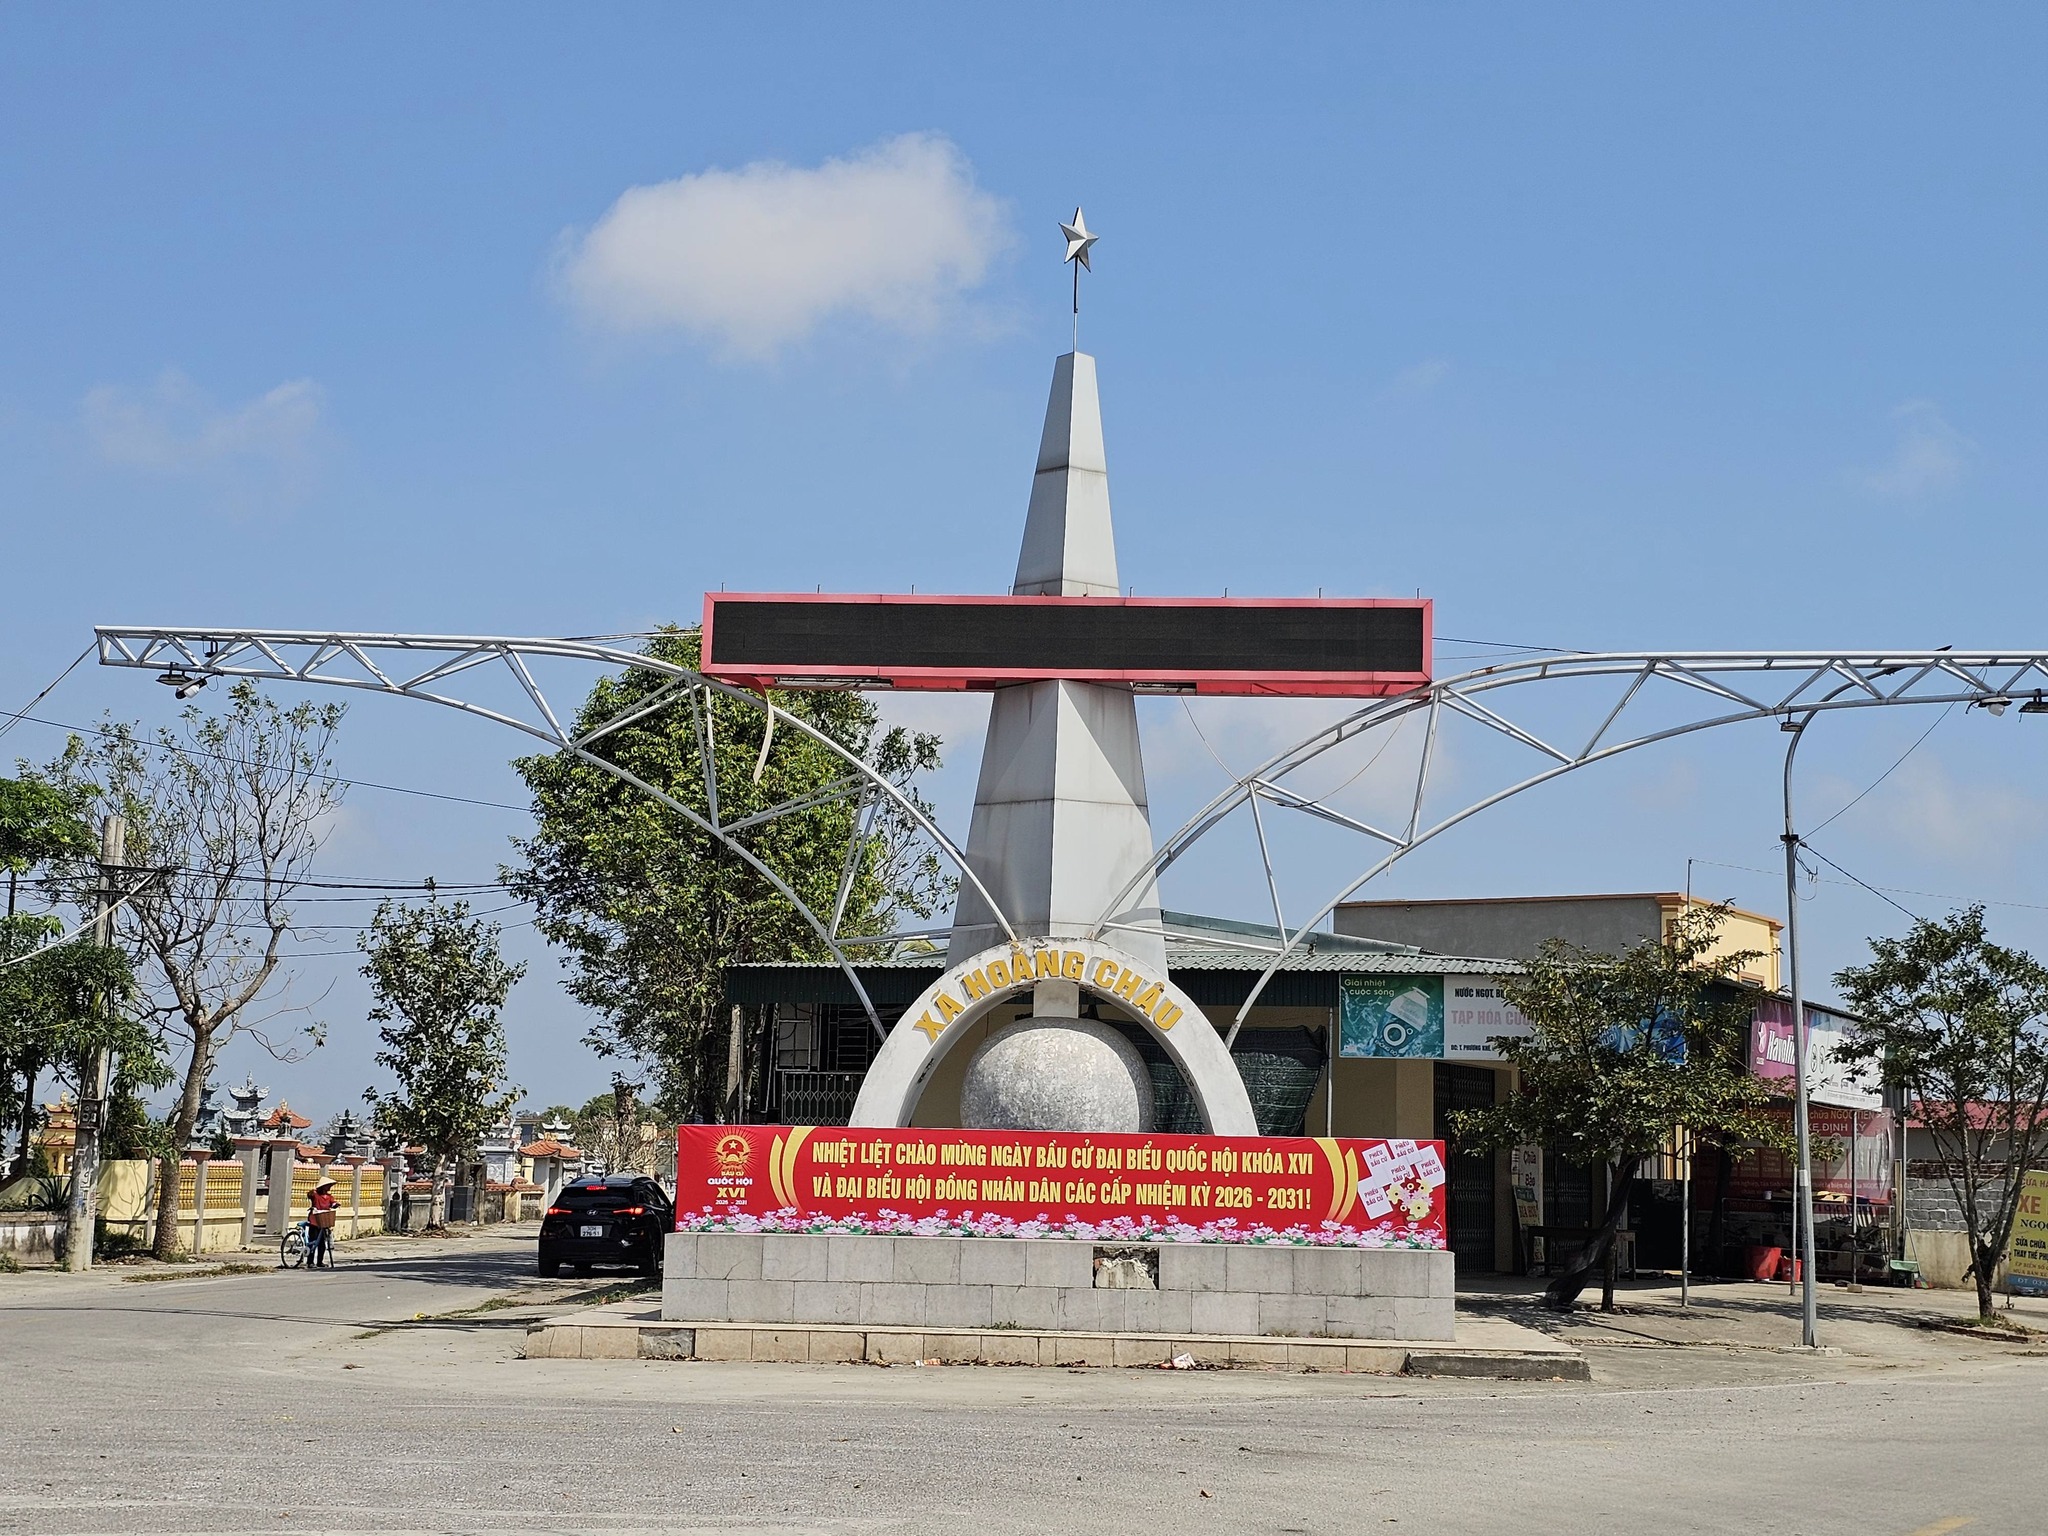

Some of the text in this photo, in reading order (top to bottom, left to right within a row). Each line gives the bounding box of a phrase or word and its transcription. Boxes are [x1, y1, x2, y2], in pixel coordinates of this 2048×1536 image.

[1344, 978, 1386, 987] Giải nhiệt
[1349, 988, 1395, 997] cuộc sống
[1455, 986, 1474, 998] NƯỚC
[912, 989, 965, 1041] XÃ
[1094, 959, 1184, 1031] CHÂU
[1451, 1010, 1474, 1028] TẠP
[1478, 1008, 1502, 1026] HÓA
[1822, 1123, 1848, 1133] ĐỊNH
[812, 1138, 1313, 1178] NHIỆT LIỆT CHÀO MỪNG NGÀY BẦU CỬ ĐẠI BIỂU QUỐC HỘI KHÓA XVI
[707, 1176, 753, 1186] QUỐC HỘI
[716, 1187, 746, 1198] XVI
[812, 1172, 832, 1198] VÀ
[836, 1176, 862, 1203] ĐẠI
[866, 1170, 901, 1199] BIỂU
[906, 1174, 931, 1204] HỘI
[935, 1172, 978, 1201] ĐỒNG
[982, 1176, 1025, 1202] NHÂN
[1029, 1177, 1061, 1204] DÂN
[1065, 1178, 1096, 1204] CÁC
[1100, 1176, 1132, 1205] CẤP
[1136, 1180, 1186, 1210] NHIỆM
[1190, 1181, 1211, 1207] KỲ
[1214, 1186, 1252, 1208] 2026
[2018, 1194, 2041, 1214] XE
[2016, 1236, 2046, 1250] SỬA CHỮA
[2014, 1249, 2026, 1258] THAY
[2028, 1250, 2038, 1260] THẾ
